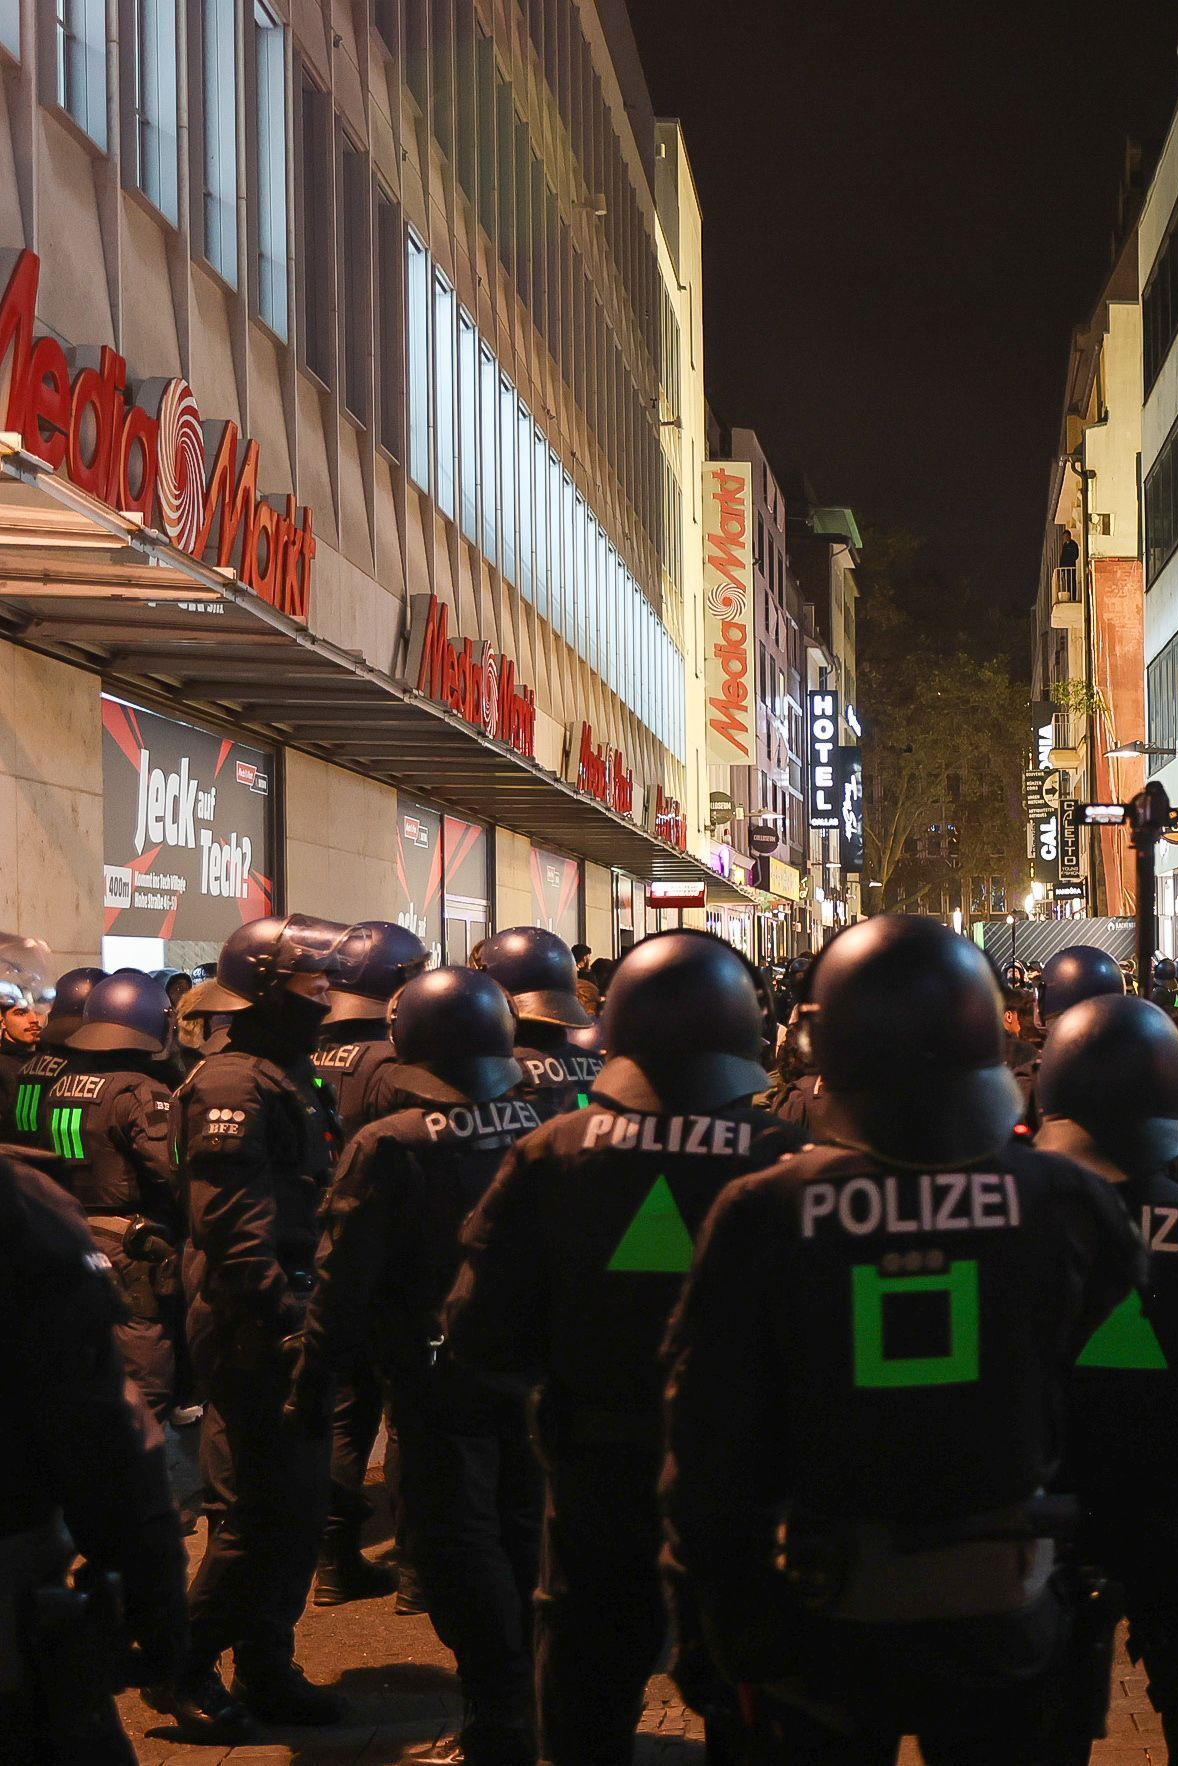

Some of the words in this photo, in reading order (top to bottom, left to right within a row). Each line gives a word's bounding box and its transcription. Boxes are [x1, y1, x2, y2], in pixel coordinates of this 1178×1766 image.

[193, 420, 316, 626] Markt
[707, 467, 747, 592] Markt
[709, 620, 749, 758] Media
[813, 695, 835, 811] HOTEL
[134, 748, 198, 856] Jeck
[197, 786, 216, 821] auf
[1063, 801, 1076, 865] CALETTO
[109, 876, 130, 898] 400m
[200, 829, 252, 898] Tech?
[208, 1123, 239, 1135] BFE
[424, 1099, 543, 1142] POLIZEI
[583, 1113, 749, 1156] POLIZEI
[802, 1173, 1021, 1238] POLIZEI
